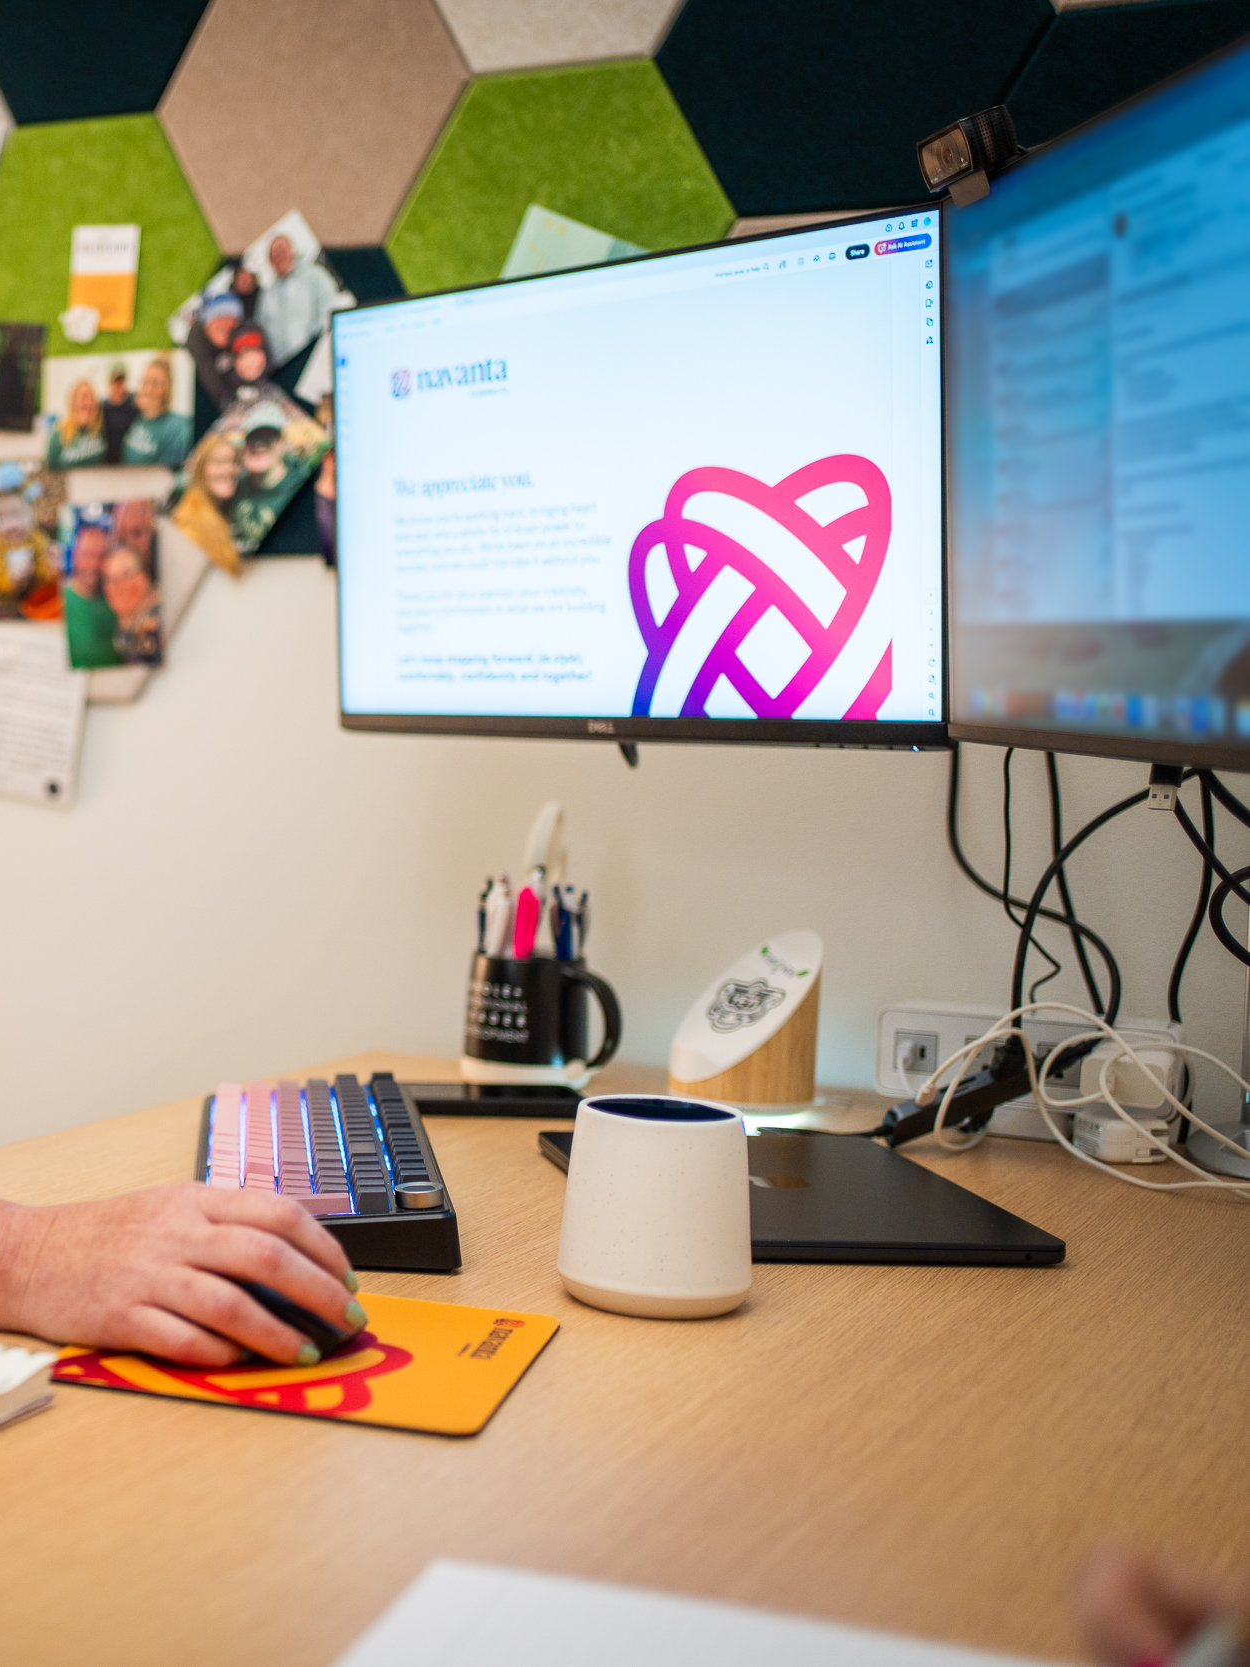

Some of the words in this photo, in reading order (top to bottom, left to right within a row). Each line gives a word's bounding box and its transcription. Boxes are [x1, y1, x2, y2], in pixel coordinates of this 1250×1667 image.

[904, 239, 925, 247] Assistant
[850, 249, 865, 257] Share
[417, 356, 507, 392] navanta
[393, 476, 415, 497] We
[421, 474, 496, 501] appreciate
[501, 472, 535, 495] you.
